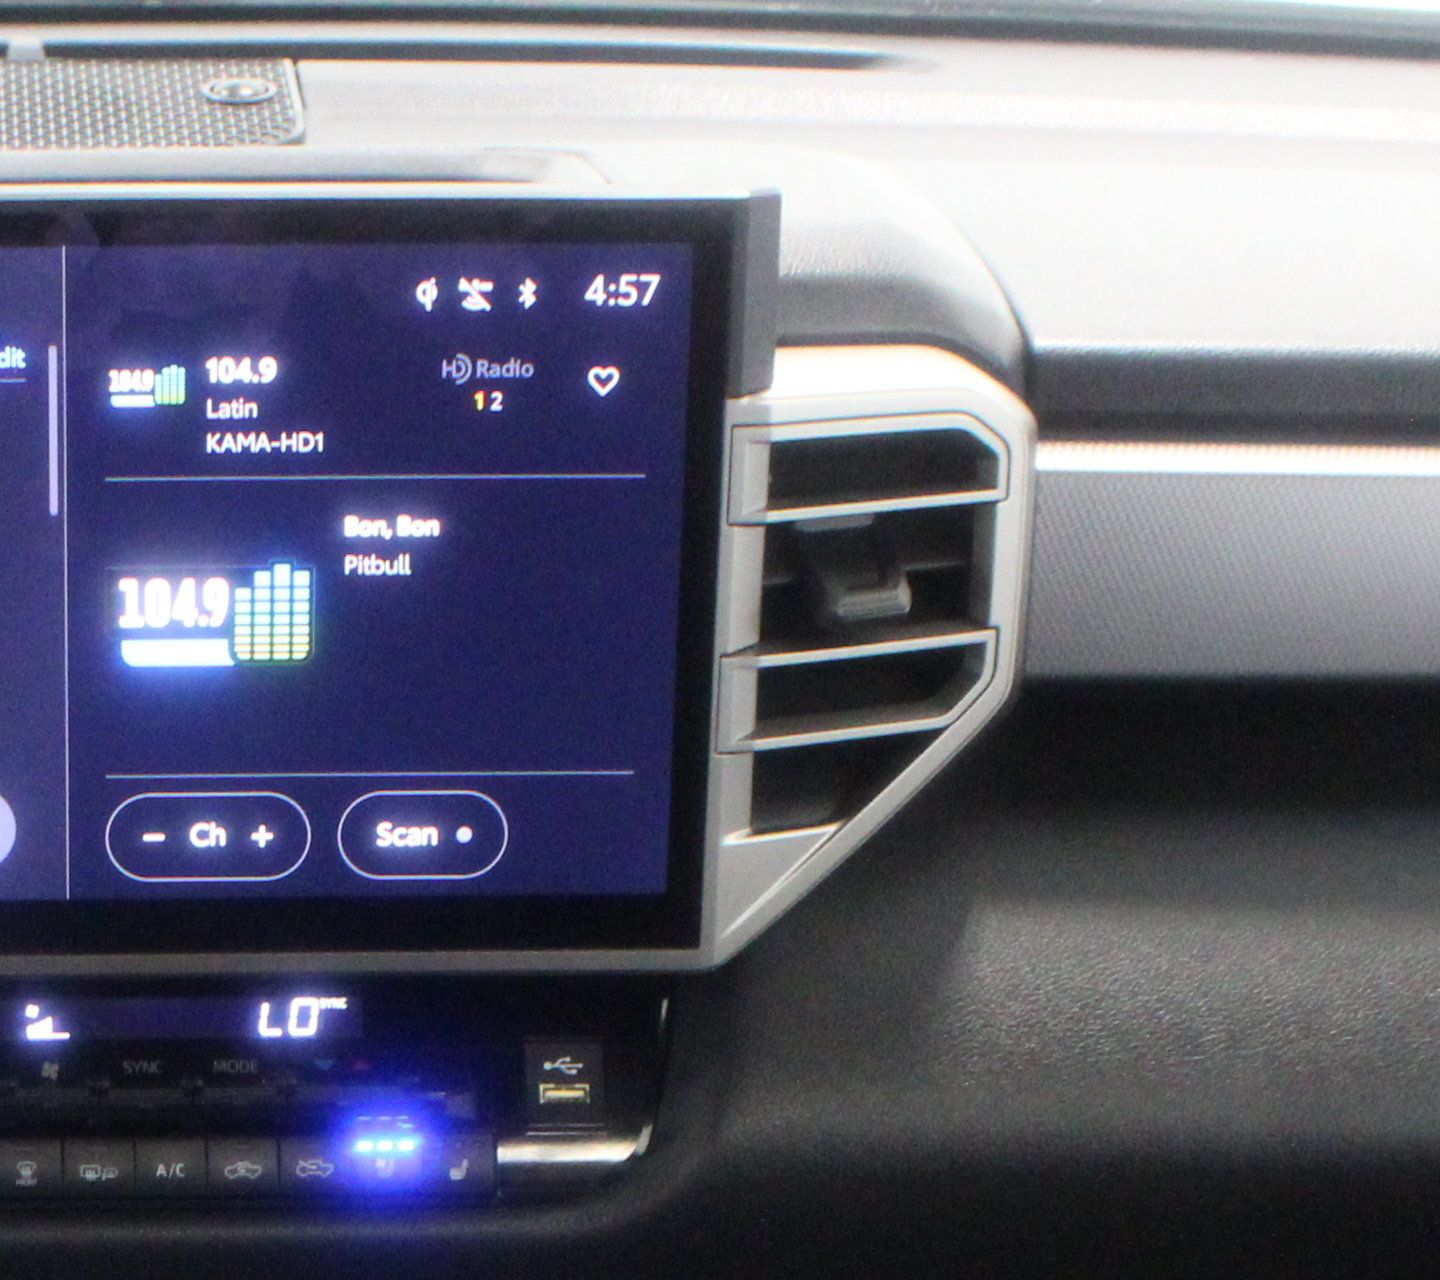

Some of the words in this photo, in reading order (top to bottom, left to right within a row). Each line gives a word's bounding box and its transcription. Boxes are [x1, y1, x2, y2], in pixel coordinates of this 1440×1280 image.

[584, 274, 661, 307] 4:57
[205, 356, 278, 384] 104.9
[476, 357, 535, 379] Radio
[206, 398, 258, 419] Latin
[206, 431, 325, 454] KAMA-HD1
[343, 515, 393, 540] Bon,
[396, 515, 441, 537] Bon
[343, 553, 413, 576] Pitbull
[118, 577, 230, 628] 104.9
[189, 821, 227, 847] Ch
[375, 821, 439, 847] Scan
[258, 996, 320, 1037] LO
[122, 1060, 162, 1075] SYNC
[212, 1060, 260, 1075] MODE
[155, 1163, 185, 1179] A/C
